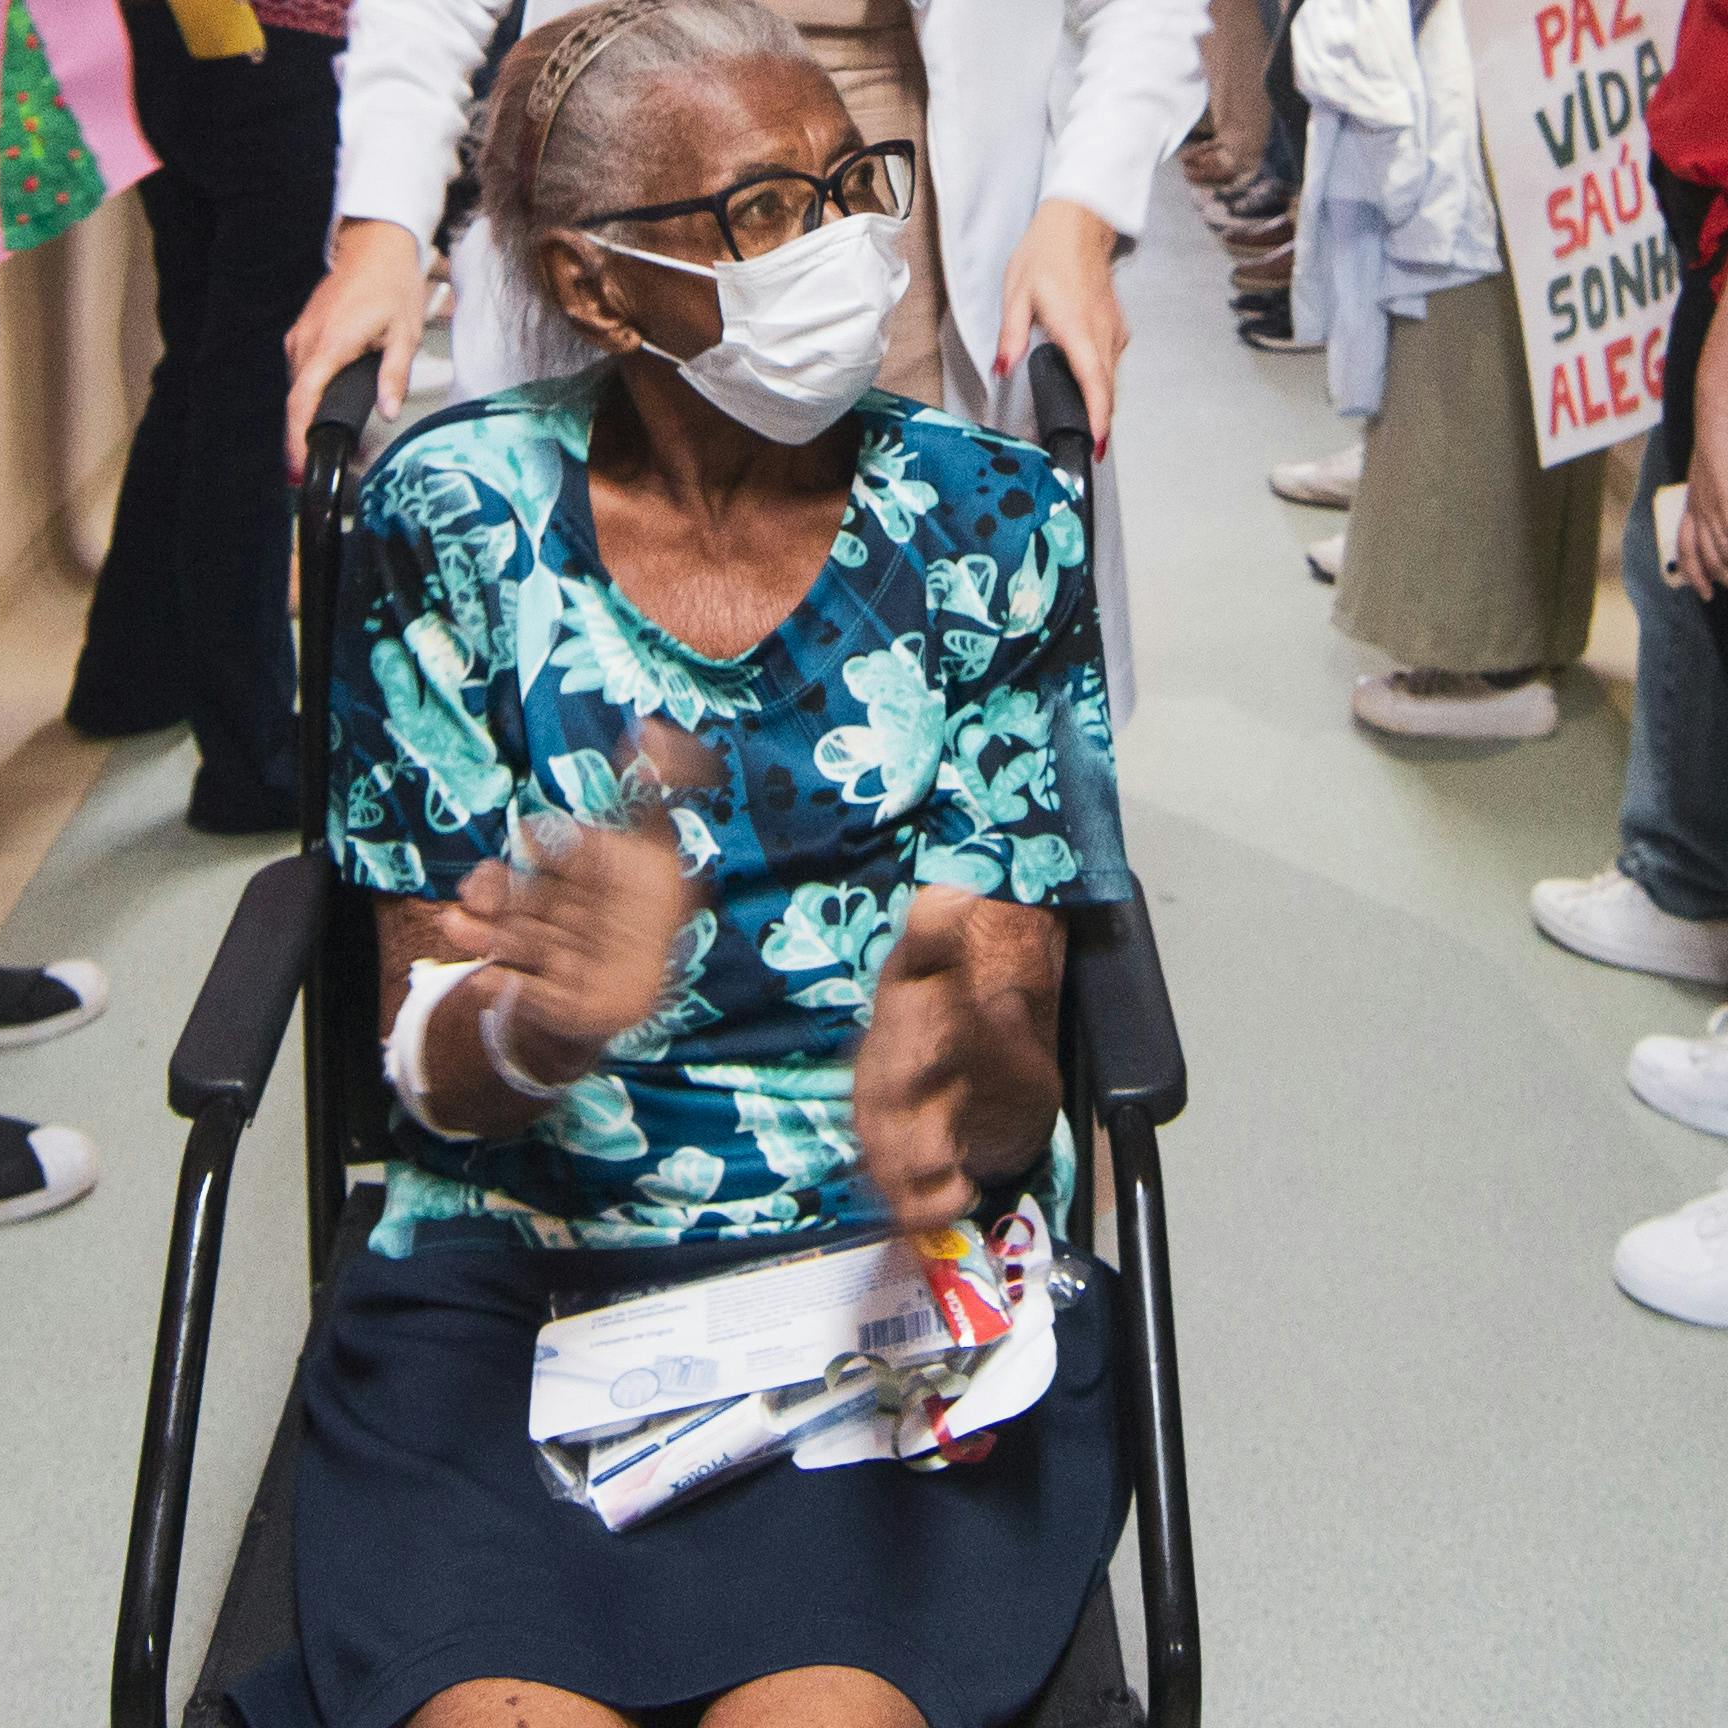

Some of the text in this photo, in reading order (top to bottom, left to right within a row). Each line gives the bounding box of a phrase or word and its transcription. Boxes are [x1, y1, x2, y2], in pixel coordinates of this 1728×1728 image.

[1534, 38, 1664, 169] VIDA
[1545, 142, 1659, 261] SAÚ
[1549, 327, 1666, 440] ALEG
